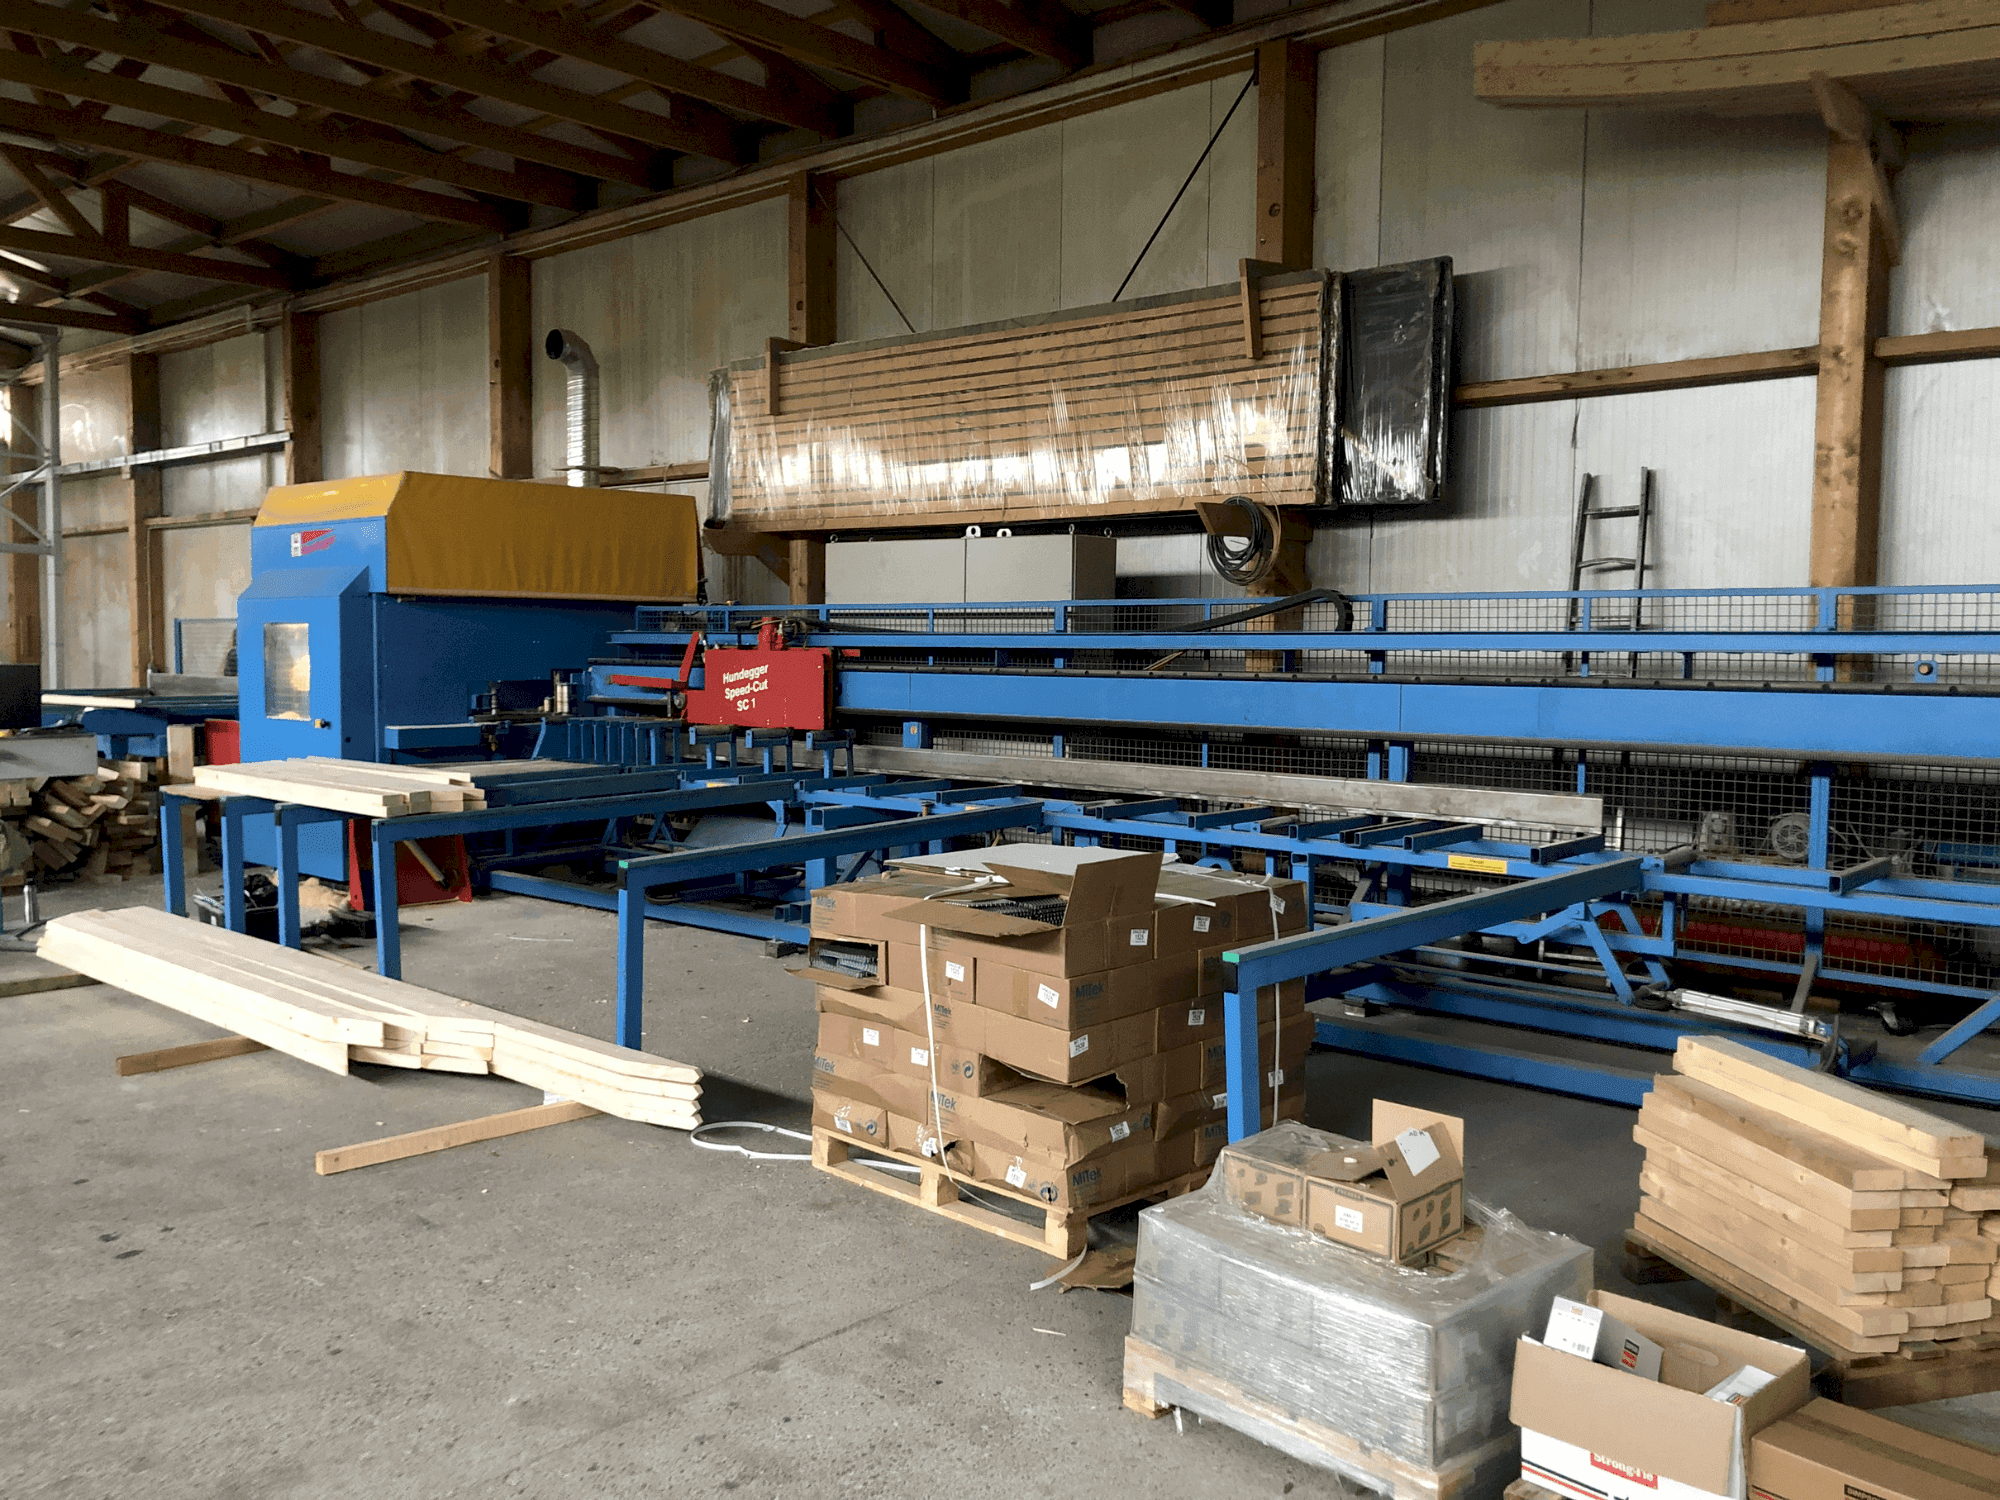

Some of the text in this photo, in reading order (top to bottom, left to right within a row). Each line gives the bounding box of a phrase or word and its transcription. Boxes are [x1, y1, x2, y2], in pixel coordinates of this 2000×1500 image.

[722, 664, 769, 684] Hundegger
[724, 679, 769, 701] Speed-Cut
[736, 697, 756, 712] SC 1
[814, 1056, 835, 1073] MiTek
[930, 1090, 957, 1110] MiTek
[1072, 1166, 1102, 1187] MiTek
